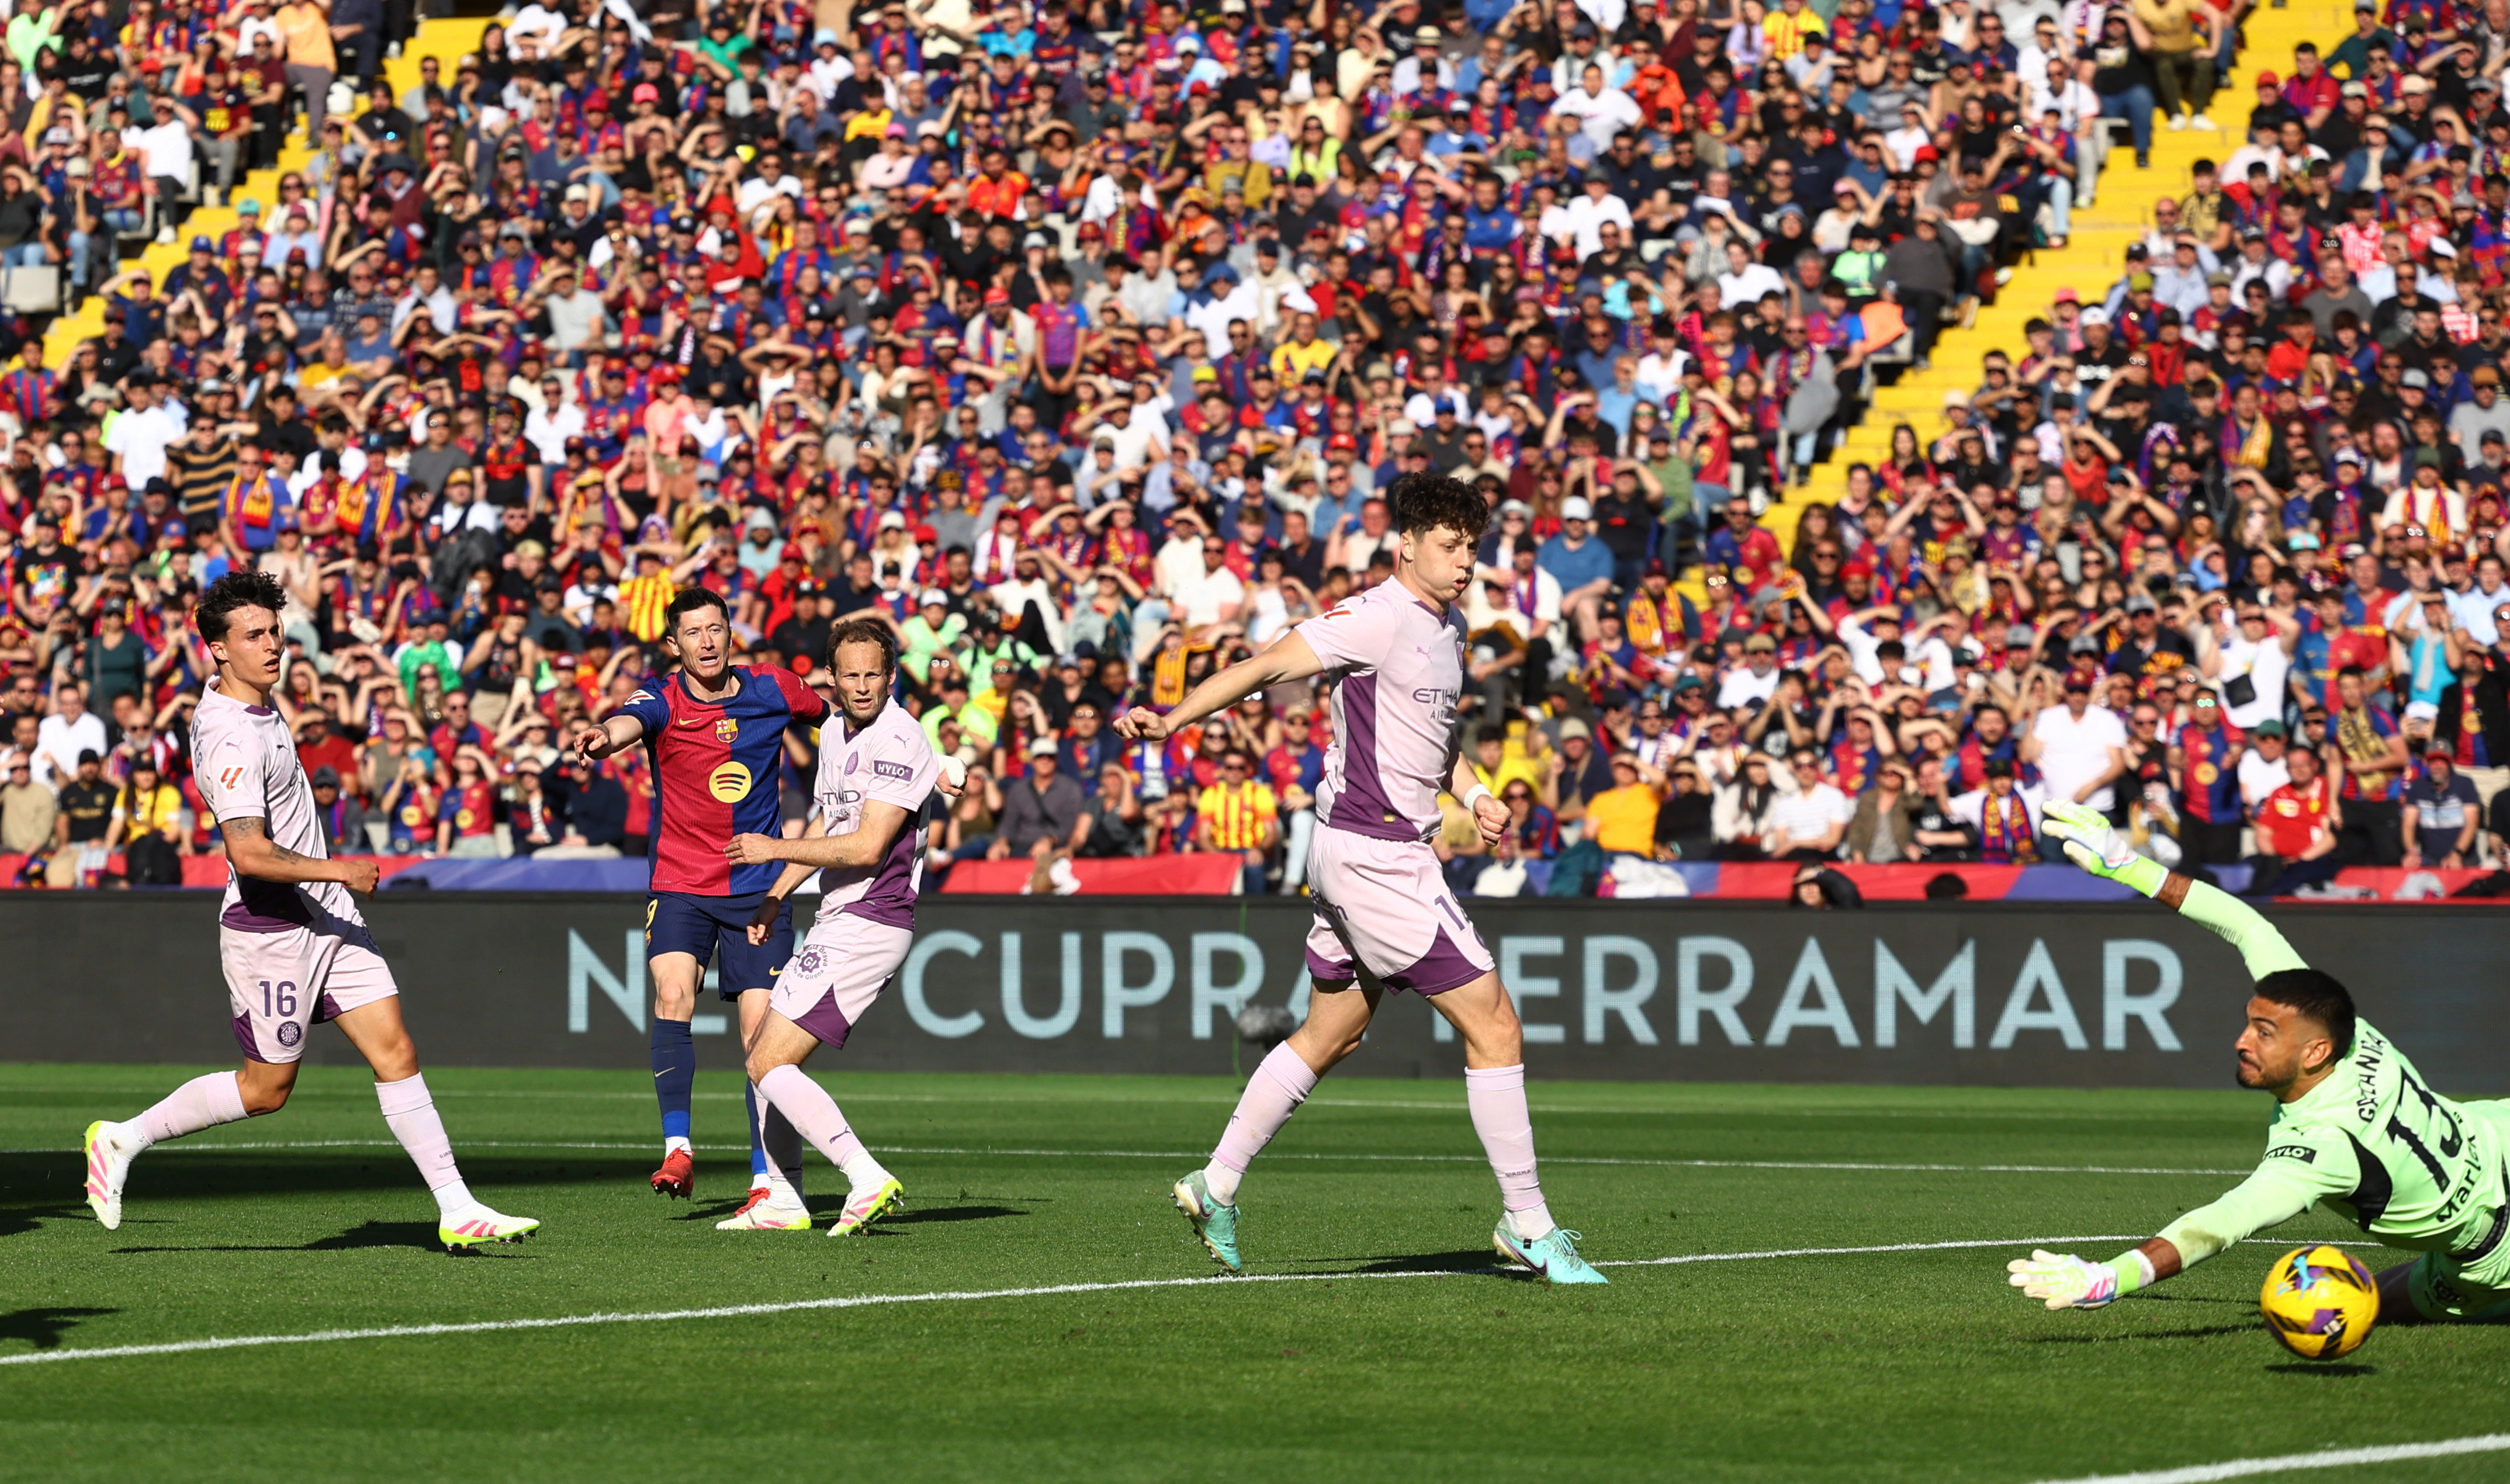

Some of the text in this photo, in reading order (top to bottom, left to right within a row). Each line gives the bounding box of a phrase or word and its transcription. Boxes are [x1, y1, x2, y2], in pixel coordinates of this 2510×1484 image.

[1412, 688, 1458, 705] ETIHA
[878, 763, 905, 776] HYLO
[646, 899, 658, 930] 9
[258, 981, 296, 1017] 16
[1434, 935, 2184, 1052] ERRAMAR
[2386, 1065, 2463, 1195] 13
